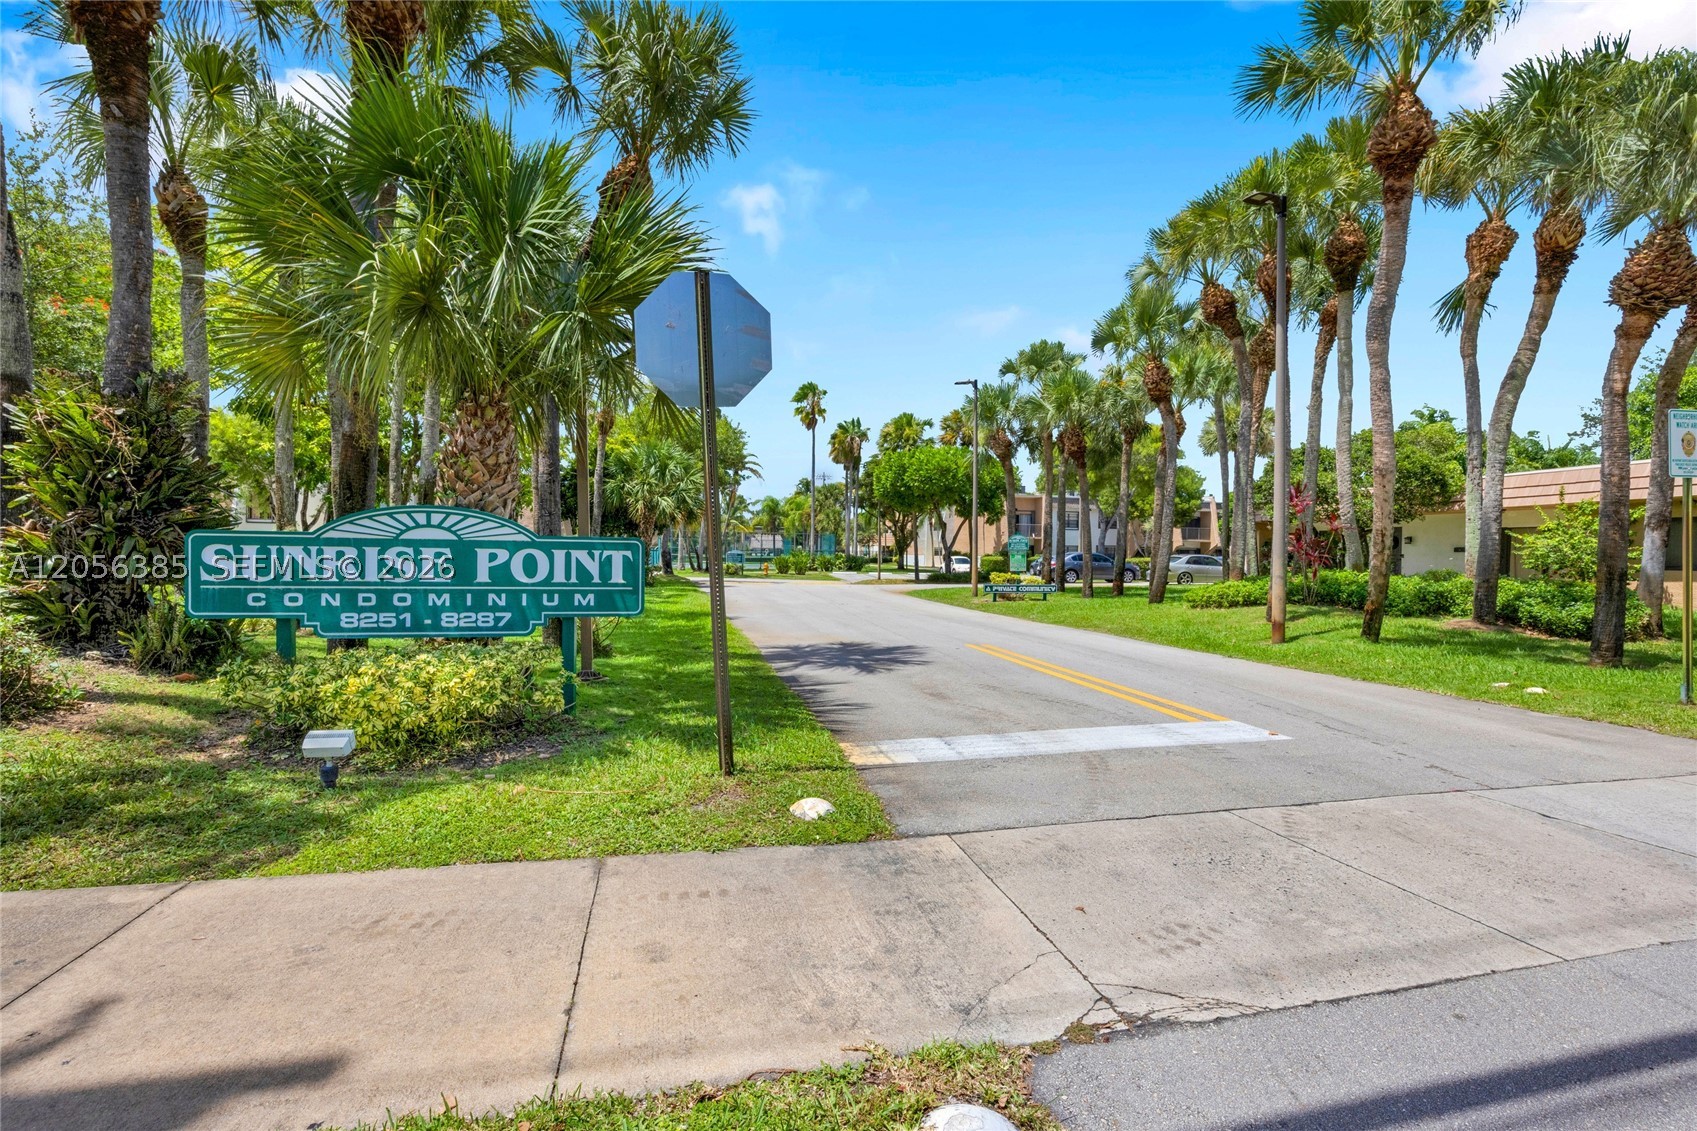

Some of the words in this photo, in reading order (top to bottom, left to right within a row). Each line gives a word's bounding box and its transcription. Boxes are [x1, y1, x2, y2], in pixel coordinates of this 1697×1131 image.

[200, 544, 452, 583] SUNRISE
[474, 548, 634, 583] POINT
[246, 592, 595, 608] CONDOMINIUM
[340, 612, 411, 628] 8251
[440, 612, 512, 628] 8287
